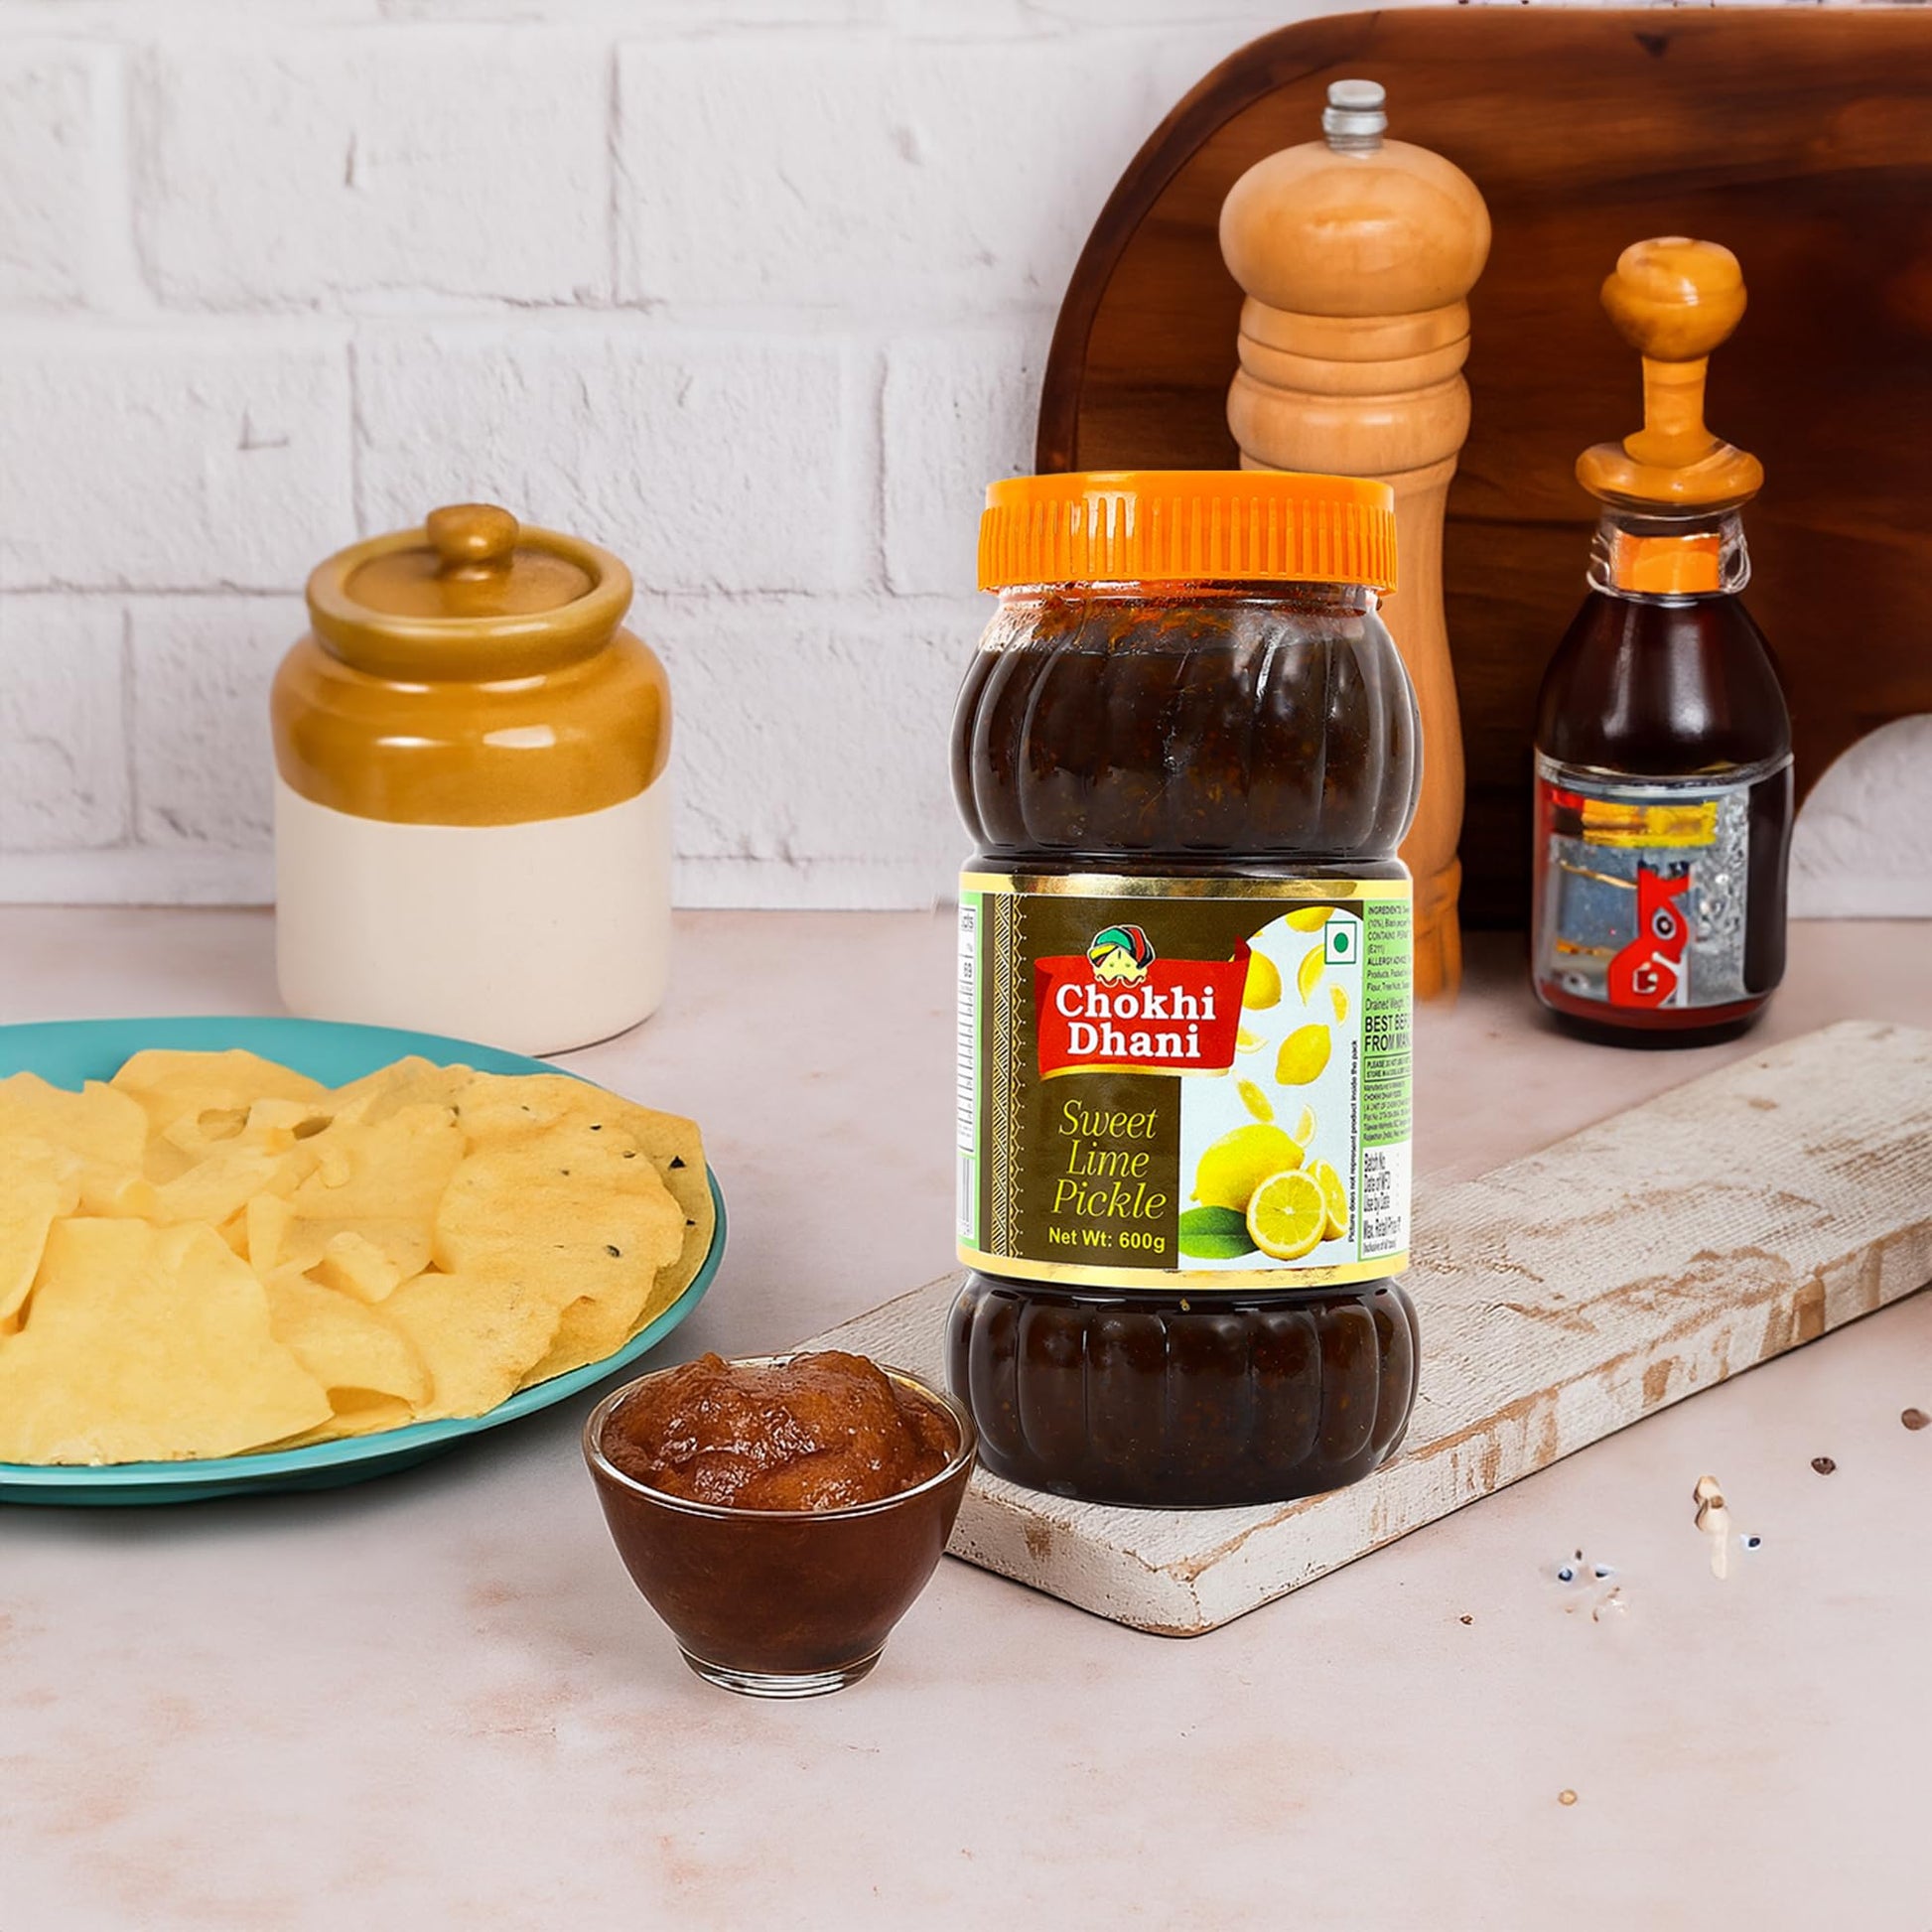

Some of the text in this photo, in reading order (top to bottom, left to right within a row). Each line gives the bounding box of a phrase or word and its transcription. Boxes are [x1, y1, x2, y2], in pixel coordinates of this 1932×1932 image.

[1055, 984, 1216, 1020] Chokhi
[1067, 1022, 1201, 1057] Dhani
[1365, 1015, 1393, 1033] BEST
[1365, 1034, 1394, 1052] FROM
[1058, 1099, 1159, 1140] Sweet
[1066, 1139, 1150, 1178] Lime
[1050, 1178, 1167, 1219] Pickle
[1048, 1226, 1166, 1254] Net Wt: 600g
